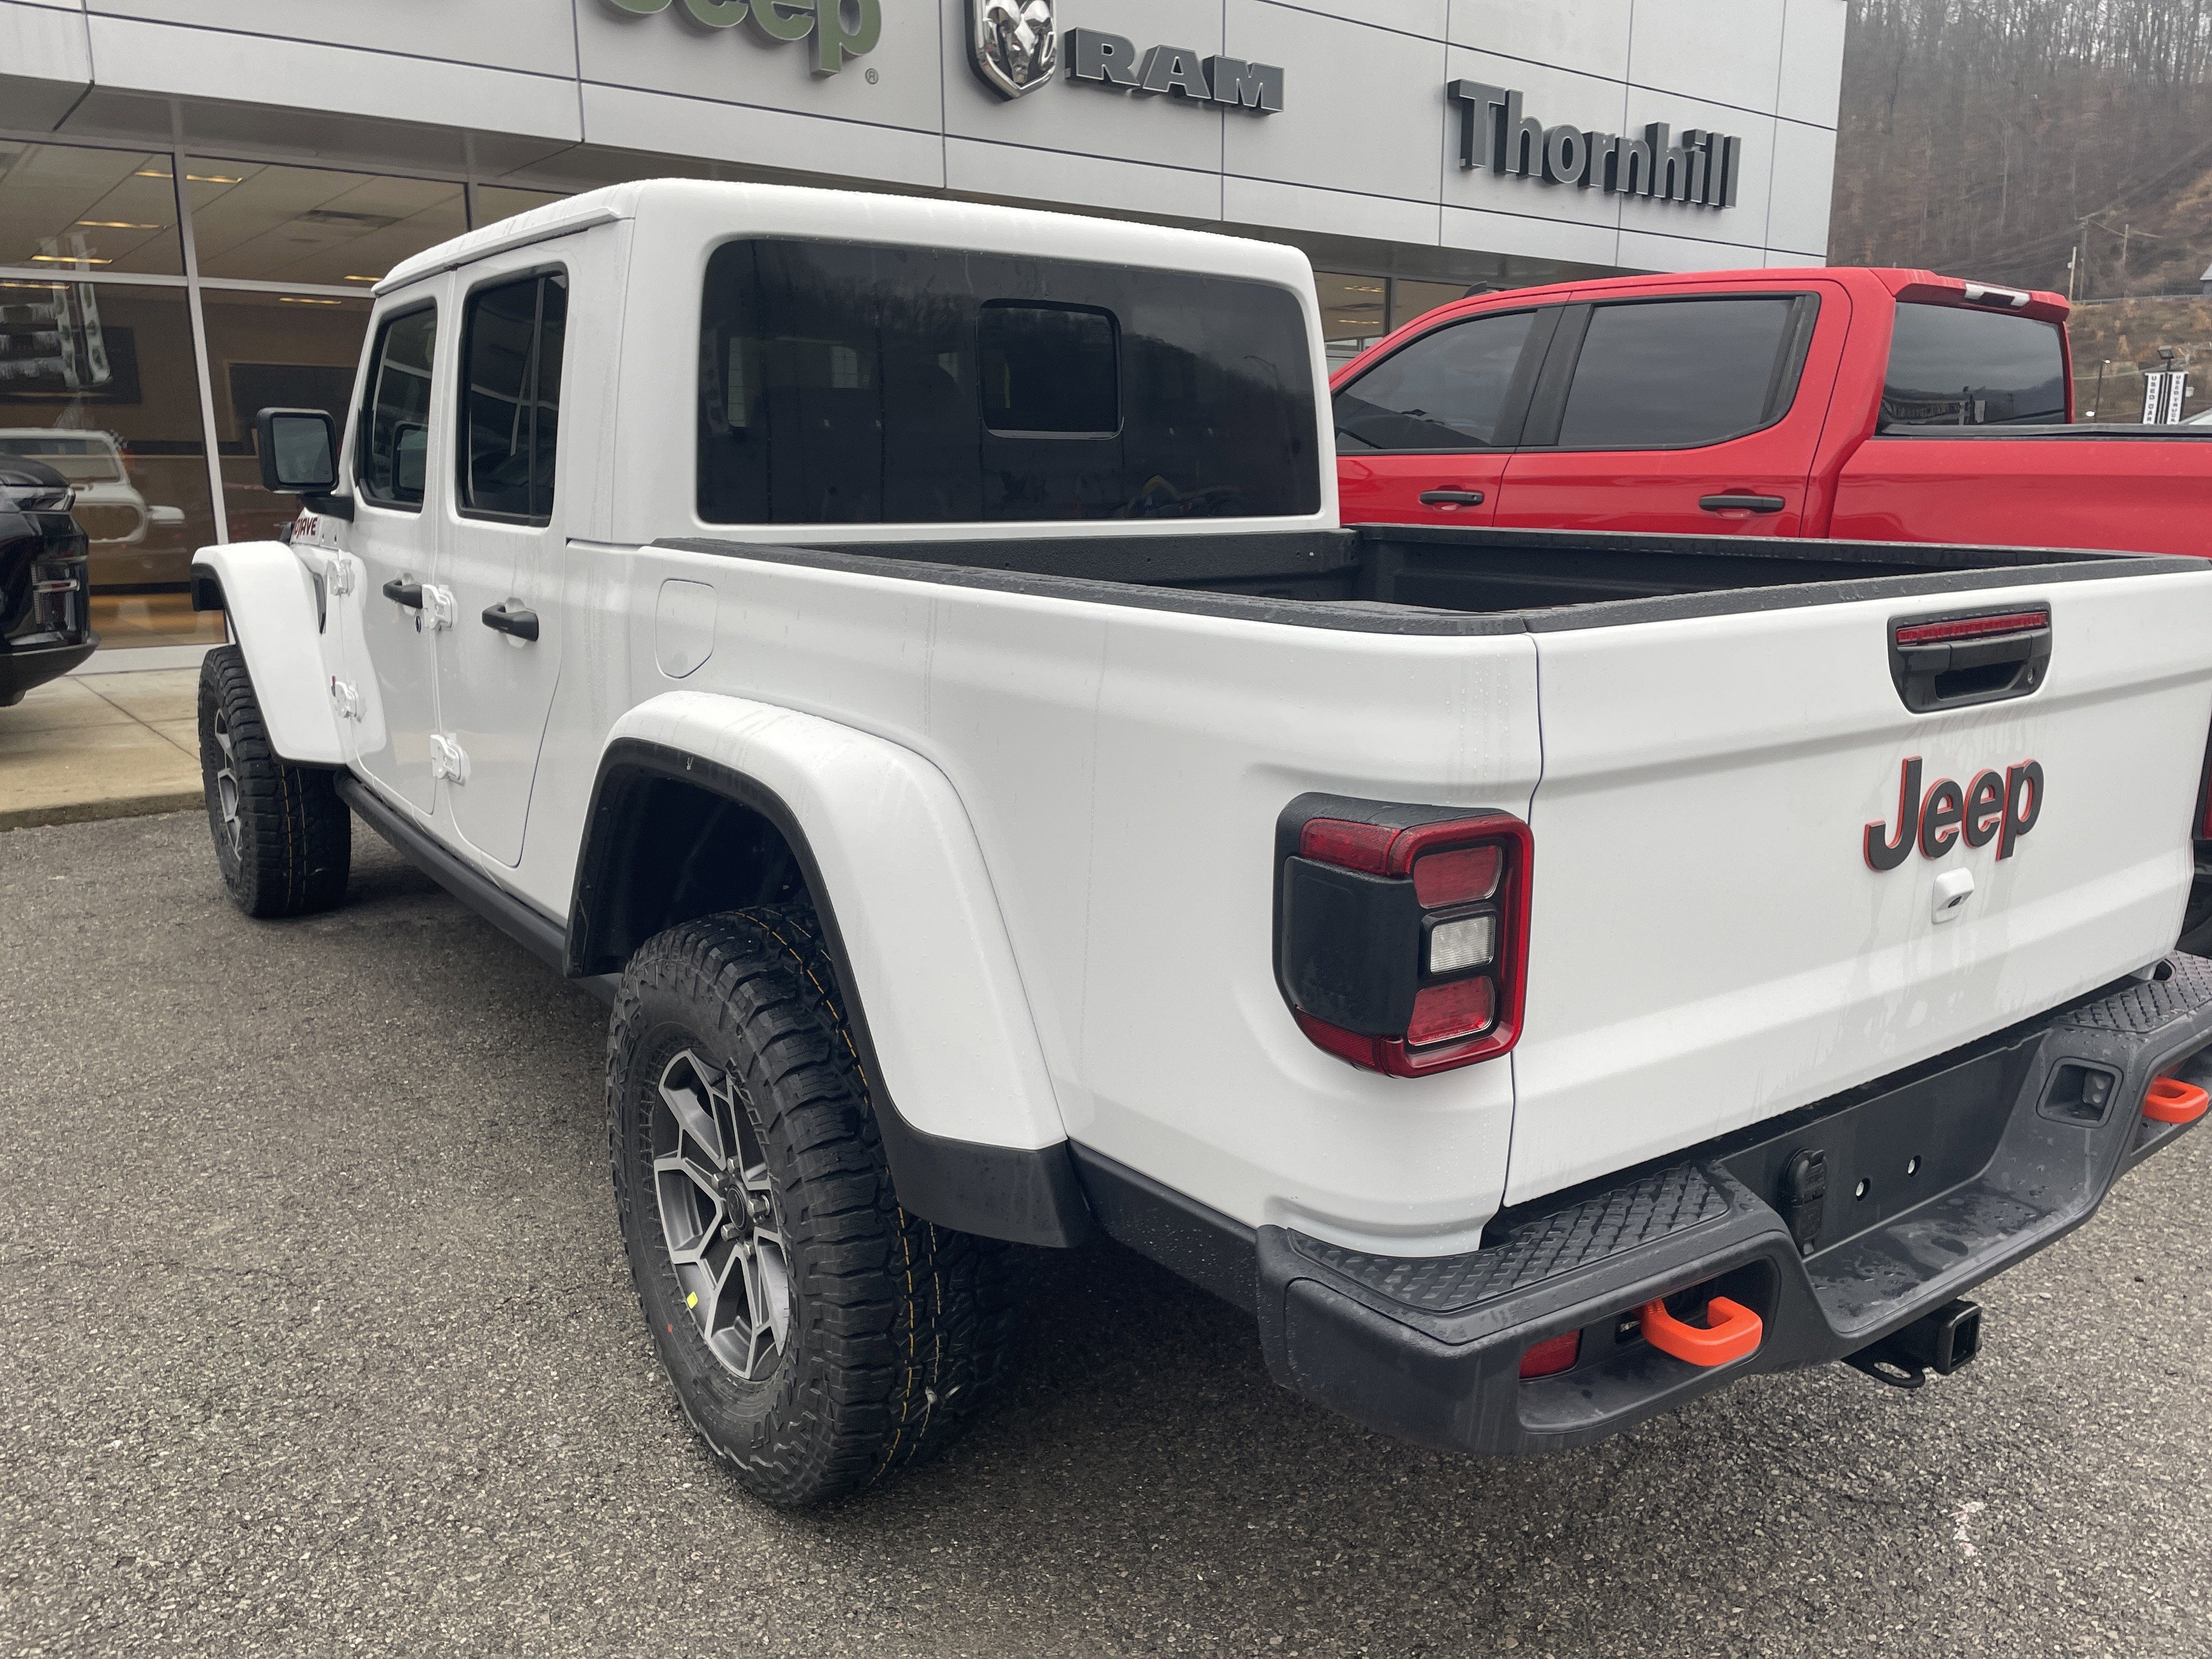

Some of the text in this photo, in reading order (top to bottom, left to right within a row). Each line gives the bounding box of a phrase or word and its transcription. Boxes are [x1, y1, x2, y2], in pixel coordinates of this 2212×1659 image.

[1065, 27, 1284, 113] RAM
[1448, 78, 1741, 208] Thornhill
[294, 517, 318, 539] OJAVE
[1864, 755, 2044, 872] Jeep
